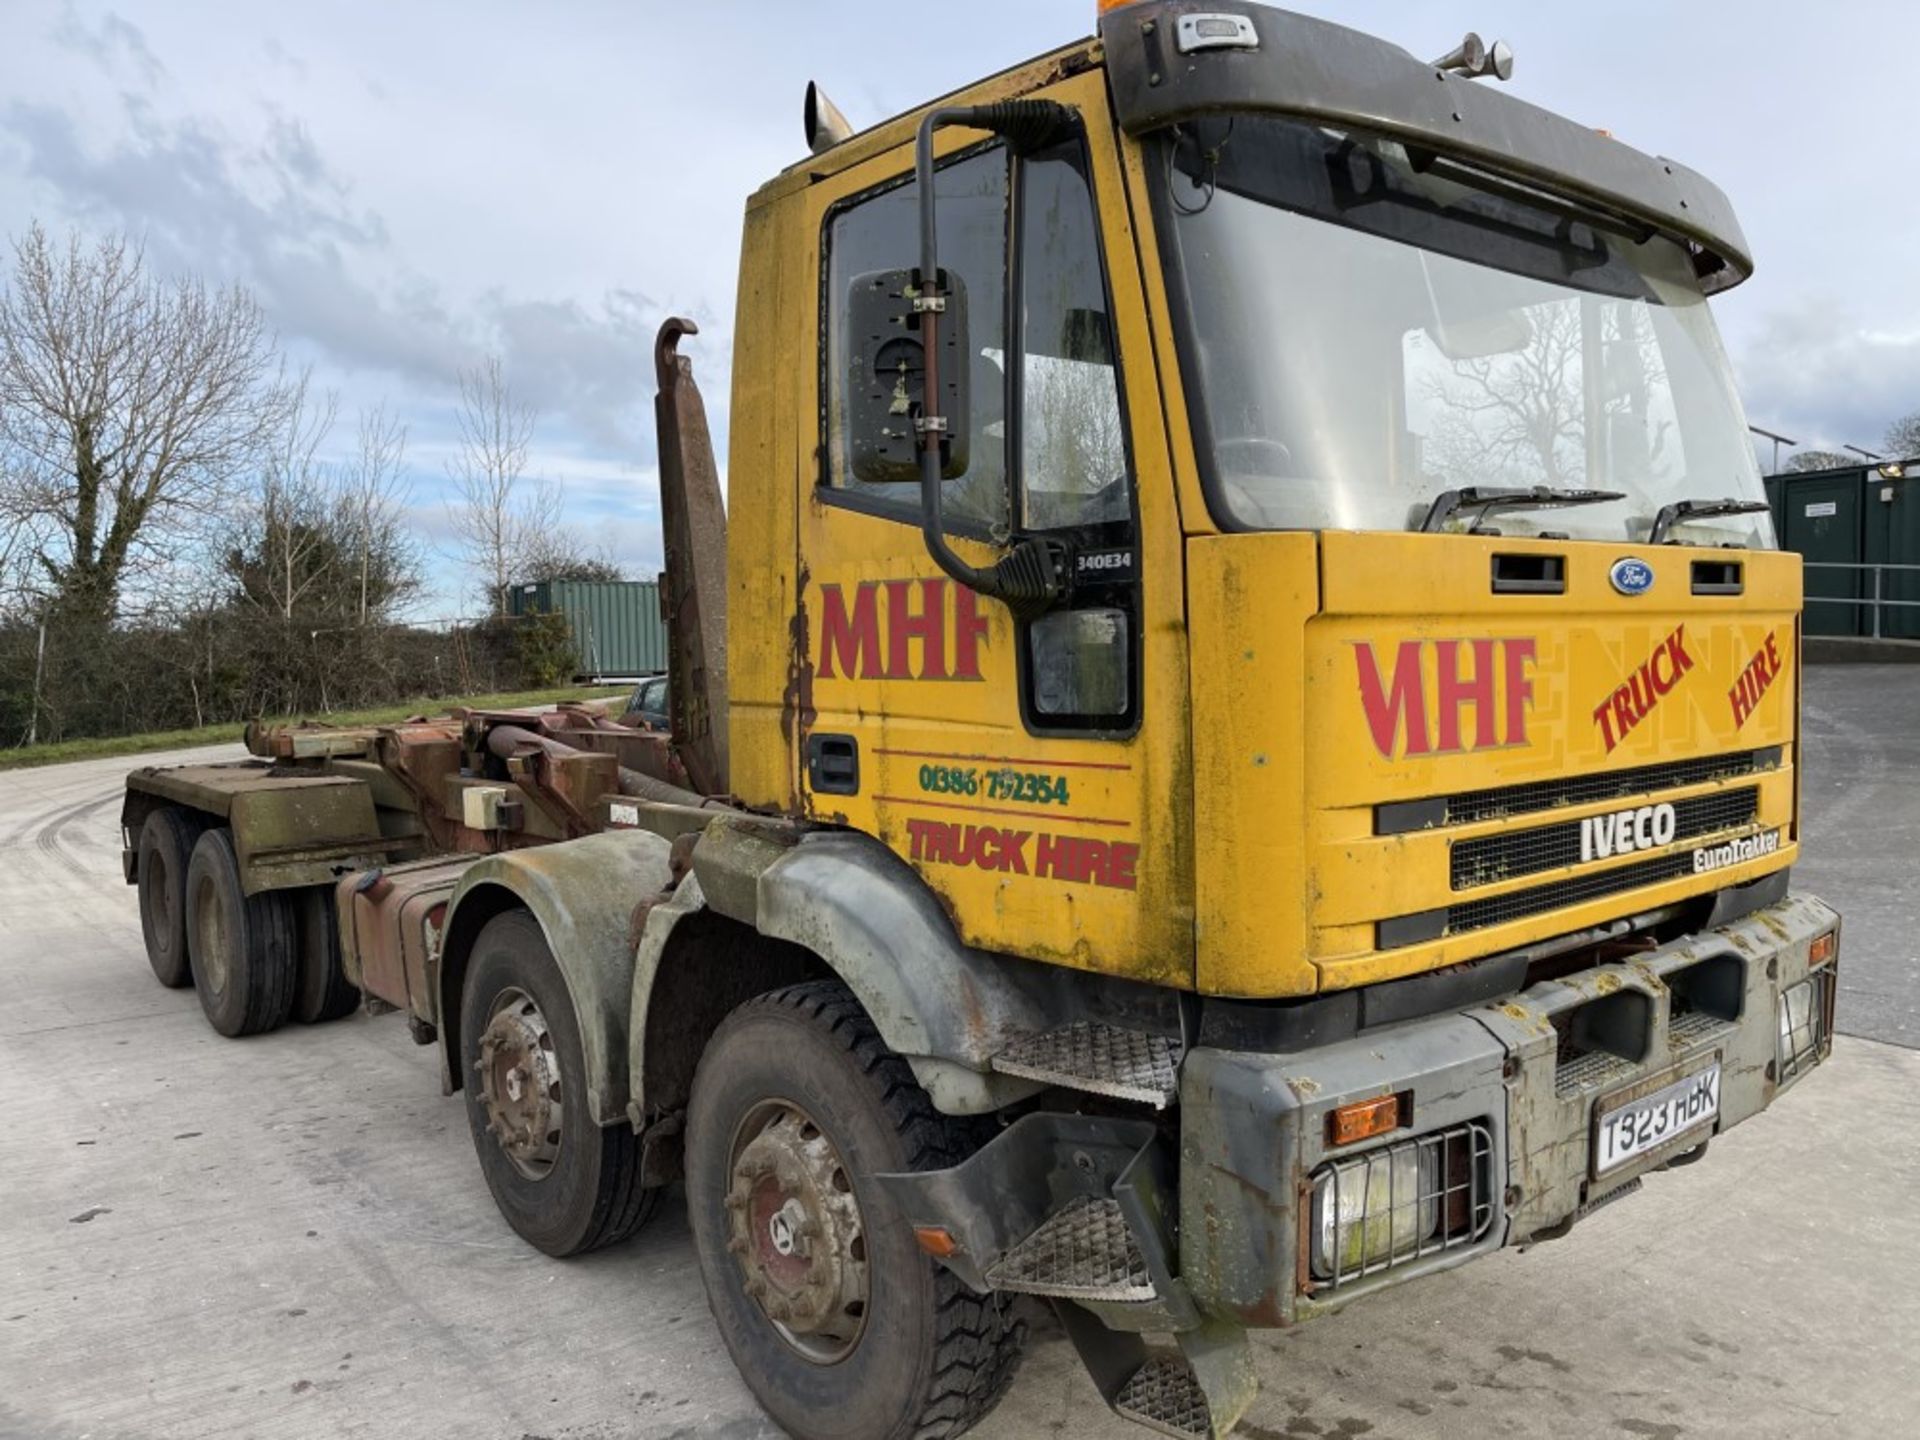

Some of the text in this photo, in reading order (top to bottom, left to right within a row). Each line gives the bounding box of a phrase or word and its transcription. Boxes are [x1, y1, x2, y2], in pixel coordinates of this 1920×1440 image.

[1077, 552, 1132, 571] 340E34
[1621, 566, 1647, 585] Ford
[815, 577, 992, 682] MHF
[1340, 635, 1538, 763] MHF
[1593, 622, 1782, 755] TRUCK HIRE
[918, 763, 979, 797] 01386
[906, 818, 1141, 892] TRUCK HIRE
[1580, 802, 1676, 862] IVECO
[1692, 829, 1779, 873] EuroTrakker
